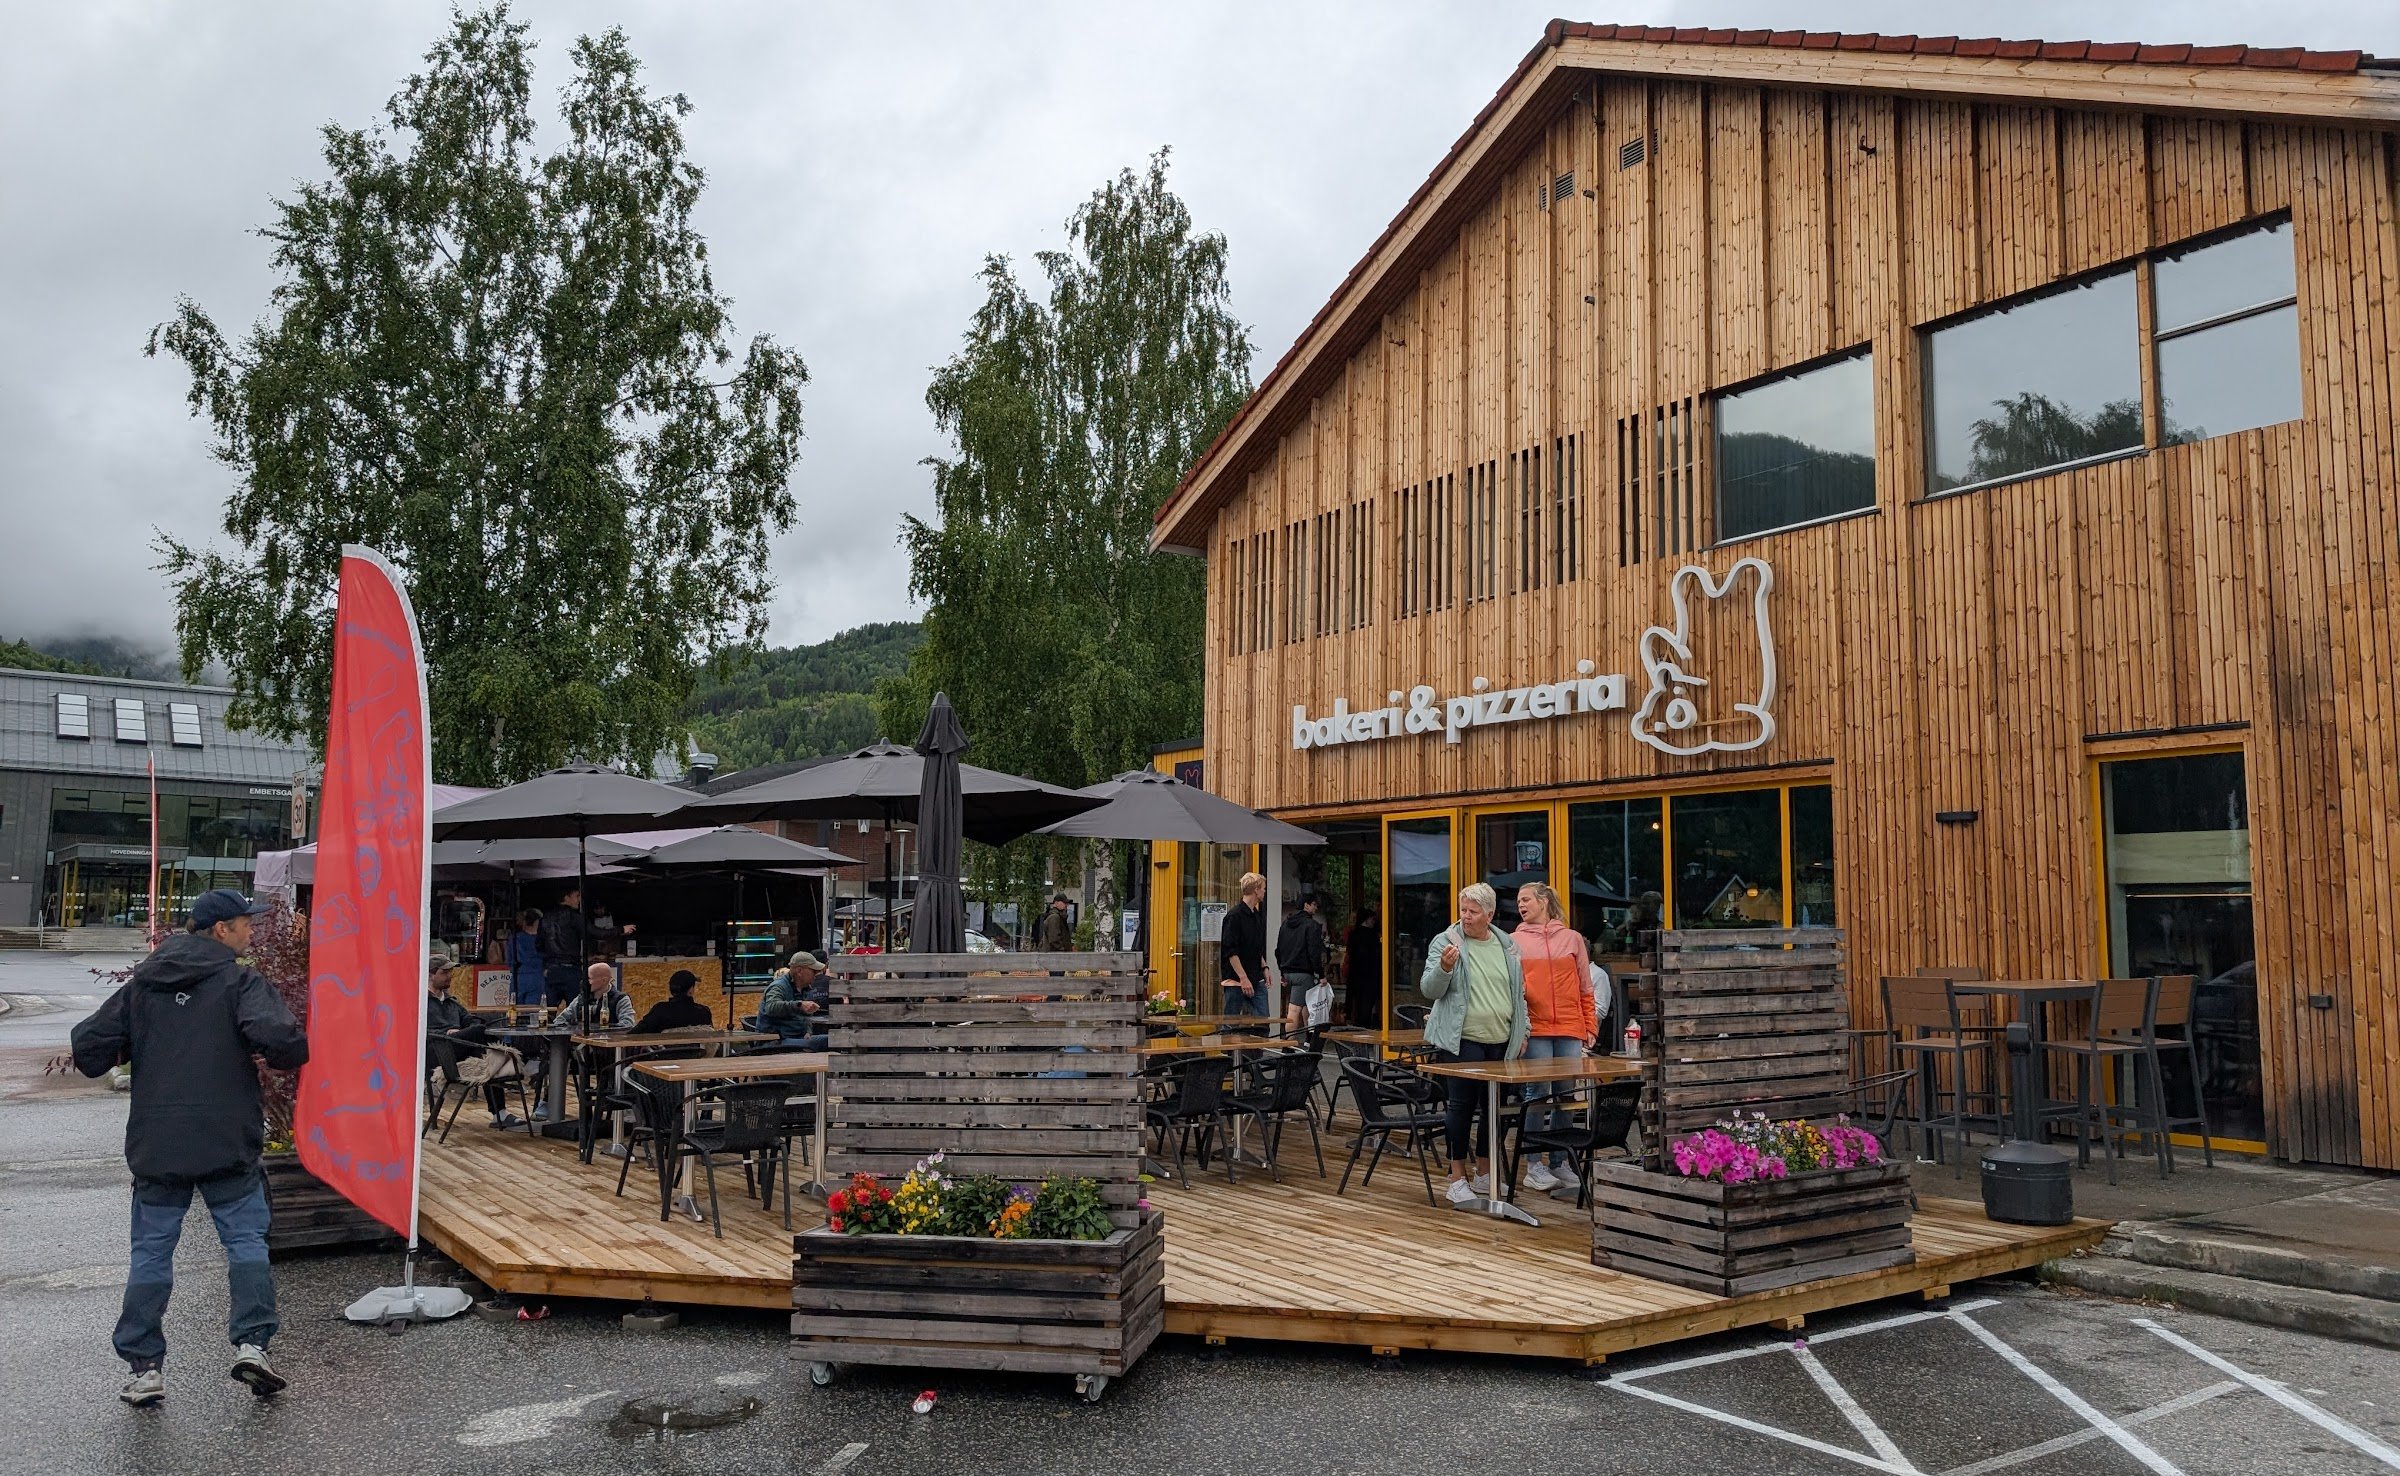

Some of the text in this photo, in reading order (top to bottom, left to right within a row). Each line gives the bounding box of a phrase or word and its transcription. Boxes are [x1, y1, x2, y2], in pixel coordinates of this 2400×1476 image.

[1293, 659, 1626, 750] bakeri & pizzeria
[249, 787, 314, 798] EMBETSGAN
[294, 803, 304, 824] 30
[110, 848, 153, 856] HOVEDINNGAN
[480, 975, 498, 988] BEAR
